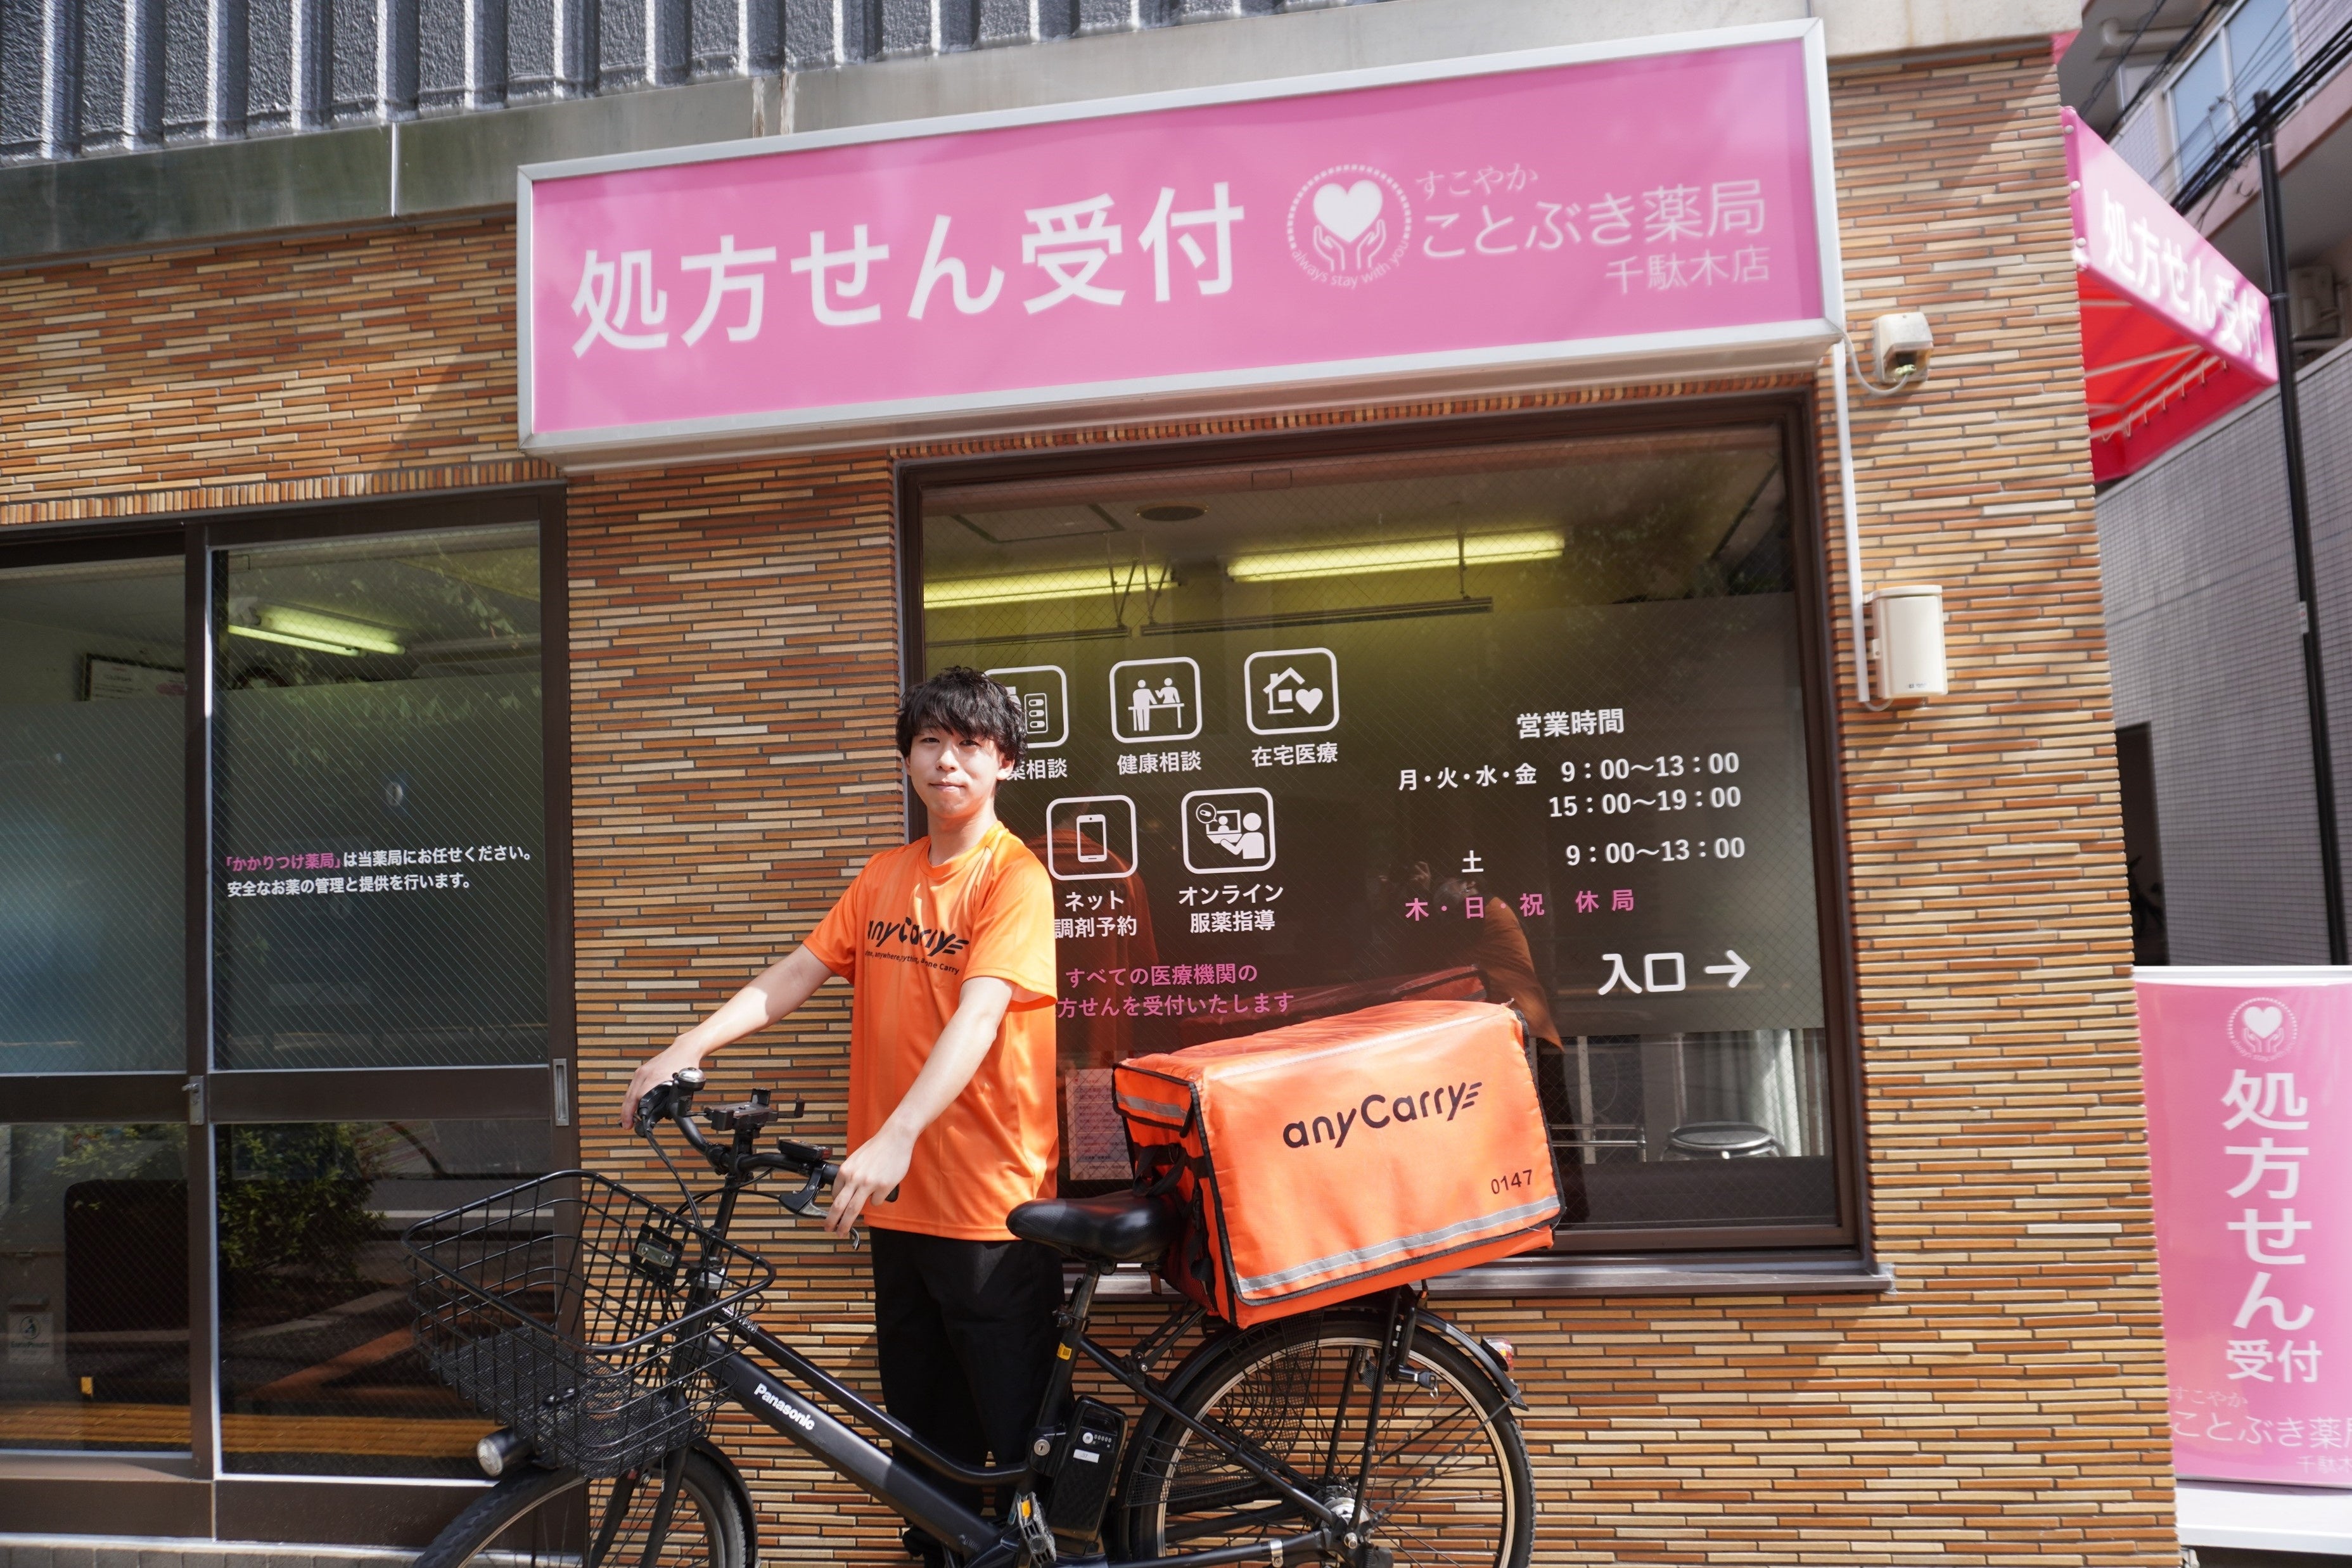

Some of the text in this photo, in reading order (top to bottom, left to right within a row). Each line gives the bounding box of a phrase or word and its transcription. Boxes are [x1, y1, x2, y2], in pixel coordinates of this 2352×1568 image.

[1415, 163, 1539, 200] すこやか
[1423, 179, 1766, 259] ことぶき薬局
[570, 181, 1244, 359] 処方せん受付
[1291, 239, 1410, 290] always stay with you
[1605, 245, 1771, 294] 千駄木店
[2102, 188, 2263, 364] 処方せん受付
[1517, 708, 1625, 739] 営業時間
[1117, 750, 1202, 775] 健康相談
[1251, 741, 1339, 768] 在宅医療
[1460, 850, 1484, 874] 土
[227, 871, 470, 898] 安全なお薬の管理と提供を行います。
[1178, 884, 1284, 908] オンライン
[1064, 889, 1124, 912] ネット
[1575, 888, 1635, 914] 休局
[1054, 915, 1137, 939] 調剤予約
[1189, 909, 1276, 934] 服薬指導
[939, 963, 960, 976] Carry
[1065, 962, 1258, 988] すべての医療機関の
[1597, 952, 1687, 995] 入口
[1058, 991, 1295, 1019] 方せんを受付いたします
[1282, 1081, 1470, 1148] anyCarry
[1491, 1169, 1533, 1195] 0147
[2221, 1068, 2315, 1332] 処方せん
[2226, 1338, 2322, 1384] 受付
[753, 1382, 815, 1431] Panasonic
[2170, 1385, 2248, 1408] すこやか
[2172, 1410, 2352, 1450] ことぶき薬
